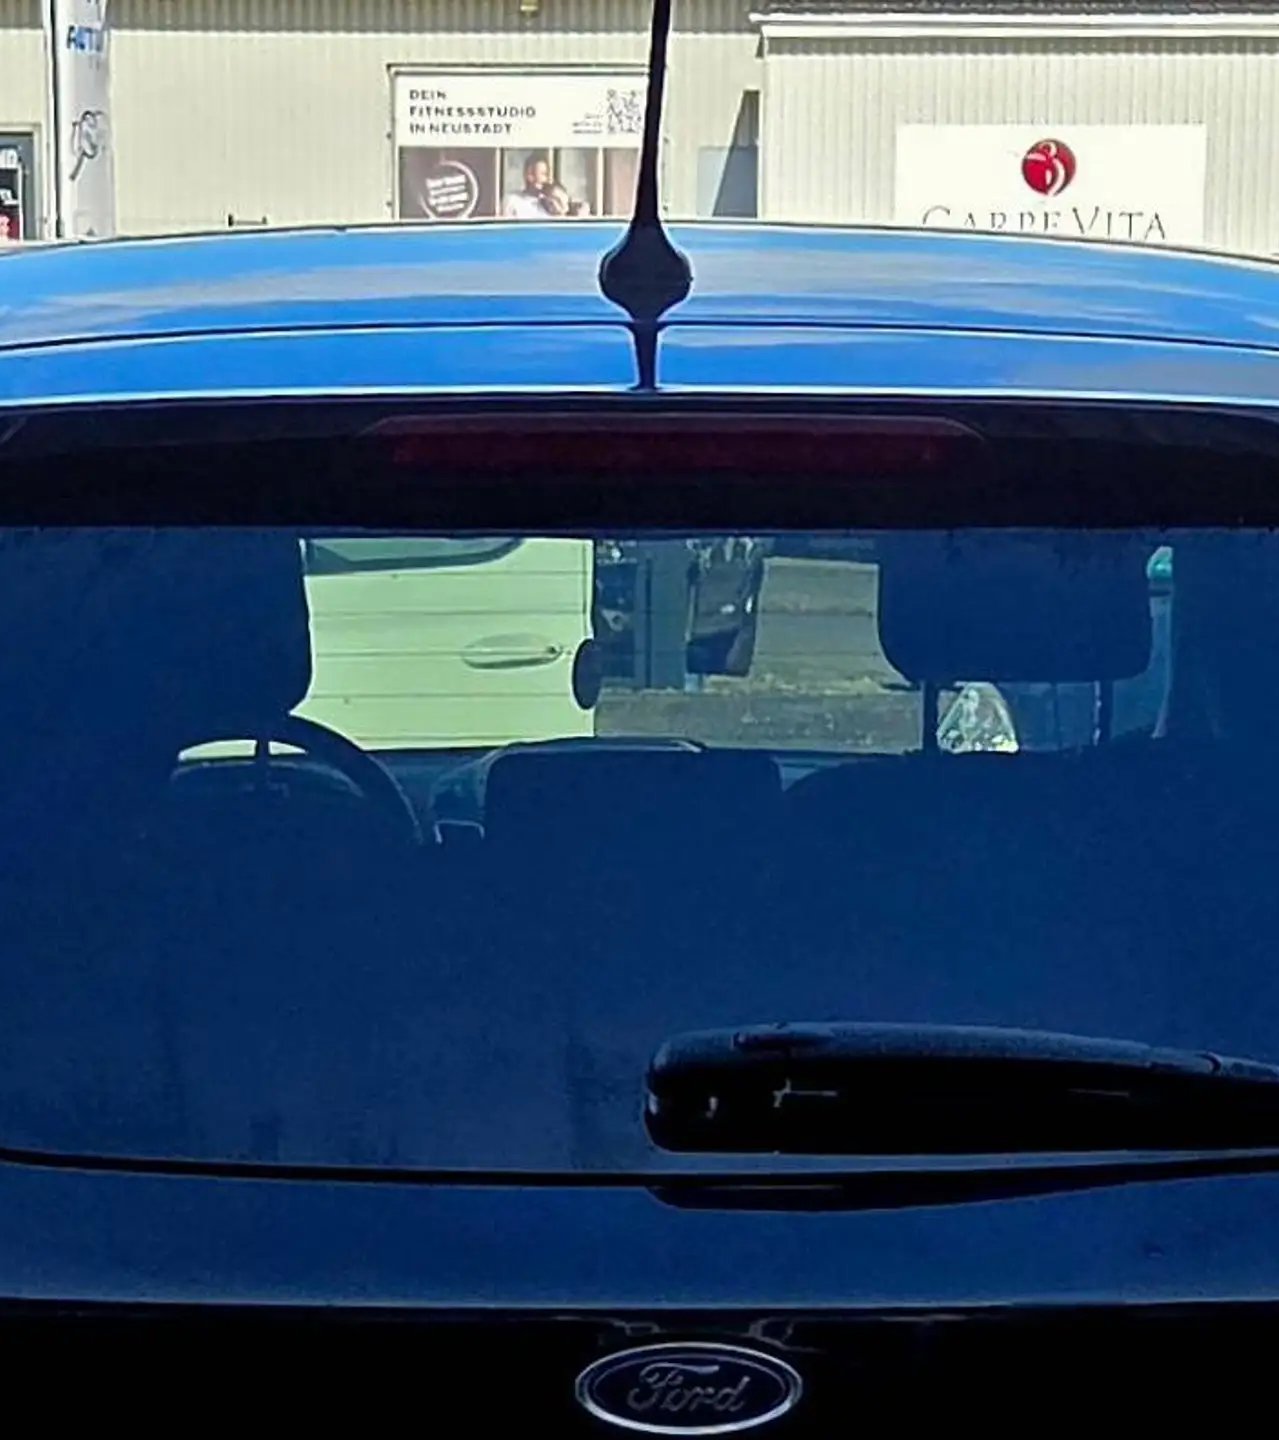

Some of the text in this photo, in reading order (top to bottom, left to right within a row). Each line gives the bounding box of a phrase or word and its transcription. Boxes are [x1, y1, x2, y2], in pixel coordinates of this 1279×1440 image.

[409, 89, 447, 100] DEIN
[409, 105, 536, 118] FITNESSSTUDIO
[409, 122, 513, 134] IN NEUSTADT
[627, 1361, 751, 1412] Ford
